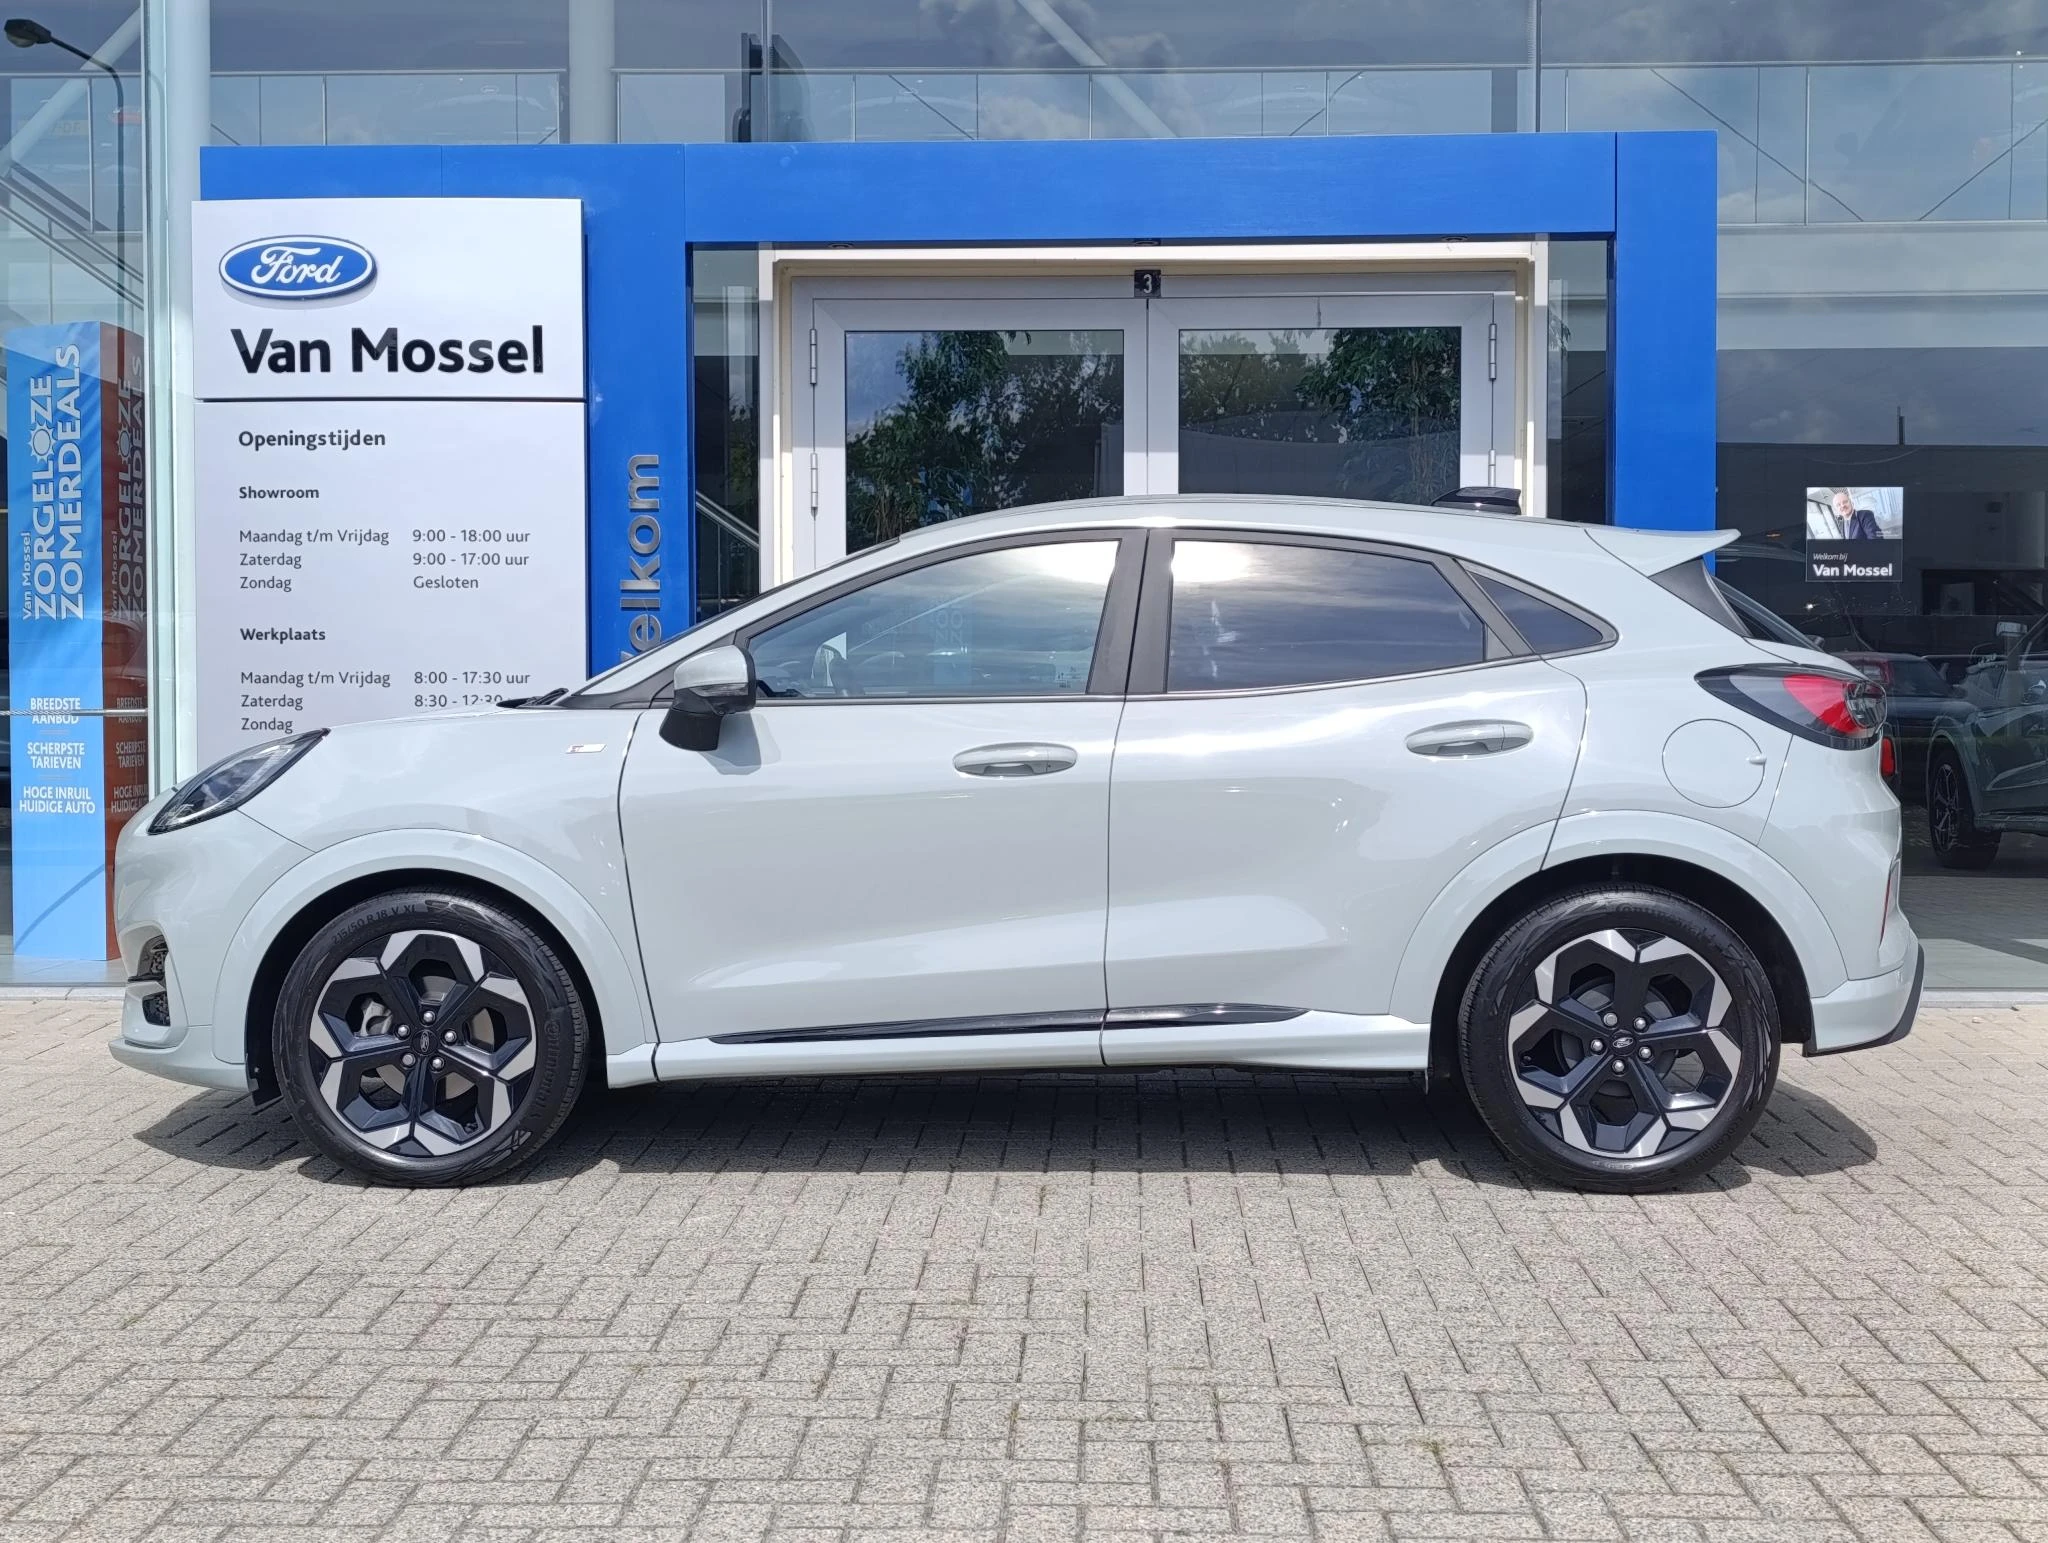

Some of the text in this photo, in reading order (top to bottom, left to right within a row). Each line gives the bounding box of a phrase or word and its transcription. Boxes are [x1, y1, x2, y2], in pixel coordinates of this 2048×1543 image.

[251, 246, 344, 284] Ford
[1143, 273, 1152, 294] 3
[230, 325, 544, 373] Van Mossel
[238, 429, 386, 451] Openingstijden
[56, 343, 84, 621] ZOMERDEALS
[239, 486, 320, 499] Showroom
[239, 529, 303, 546] Maandag
[306, 529, 333, 542] t/m
[337, 528, 390, 546] Vrijdag
[412, 529, 446, 542] 9:00
[460, 529, 502, 542] 18:00
[506, 532, 531, 542] uur
[240, 552, 302, 569] Zaterdag
[412, 552, 446, 566] 9:00
[460, 552, 501, 566] 17:00
[505, 555, 530, 566] uur
[620, 454, 662, 662] elkom
[1840, 553, 1848, 562] bij
[21, 532, 32, 620] Van Mossel
[1812, 563, 1893, 577] Van Mossel
[240, 575, 479, 593] Zondag Gesloten
[240, 627, 326, 644] Werkplaats
[240, 671, 304, 688] Maandag
[308, 671, 334, 684] t/m
[338, 670, 391, 688] Vrijdag
[414, 671, 448, 684] 8:00
[462, 671, 502, 684] 17:30
[506, 674, 530, 684] uur
[30, 697, 81, 710] BREEDSTE
[241, 694, 303, 711] Zaterdag
[414, 694, 448, 707] 8:30
[241, 717, 293, 734] Zondag
[27, 742, 85, 755] SCHERPSTE
[115, 741, 146, 754] SCHERPSTE
[30, 756, 82, 769] TARIEVEN
[118, 755, 145, 768] TARIEVEN
[23, 786, 91, 800] HOGE INRUIL
[113, 785, 132, 799] HOGE
[19, 800, 96, 814] HUIDIGE AUTO
